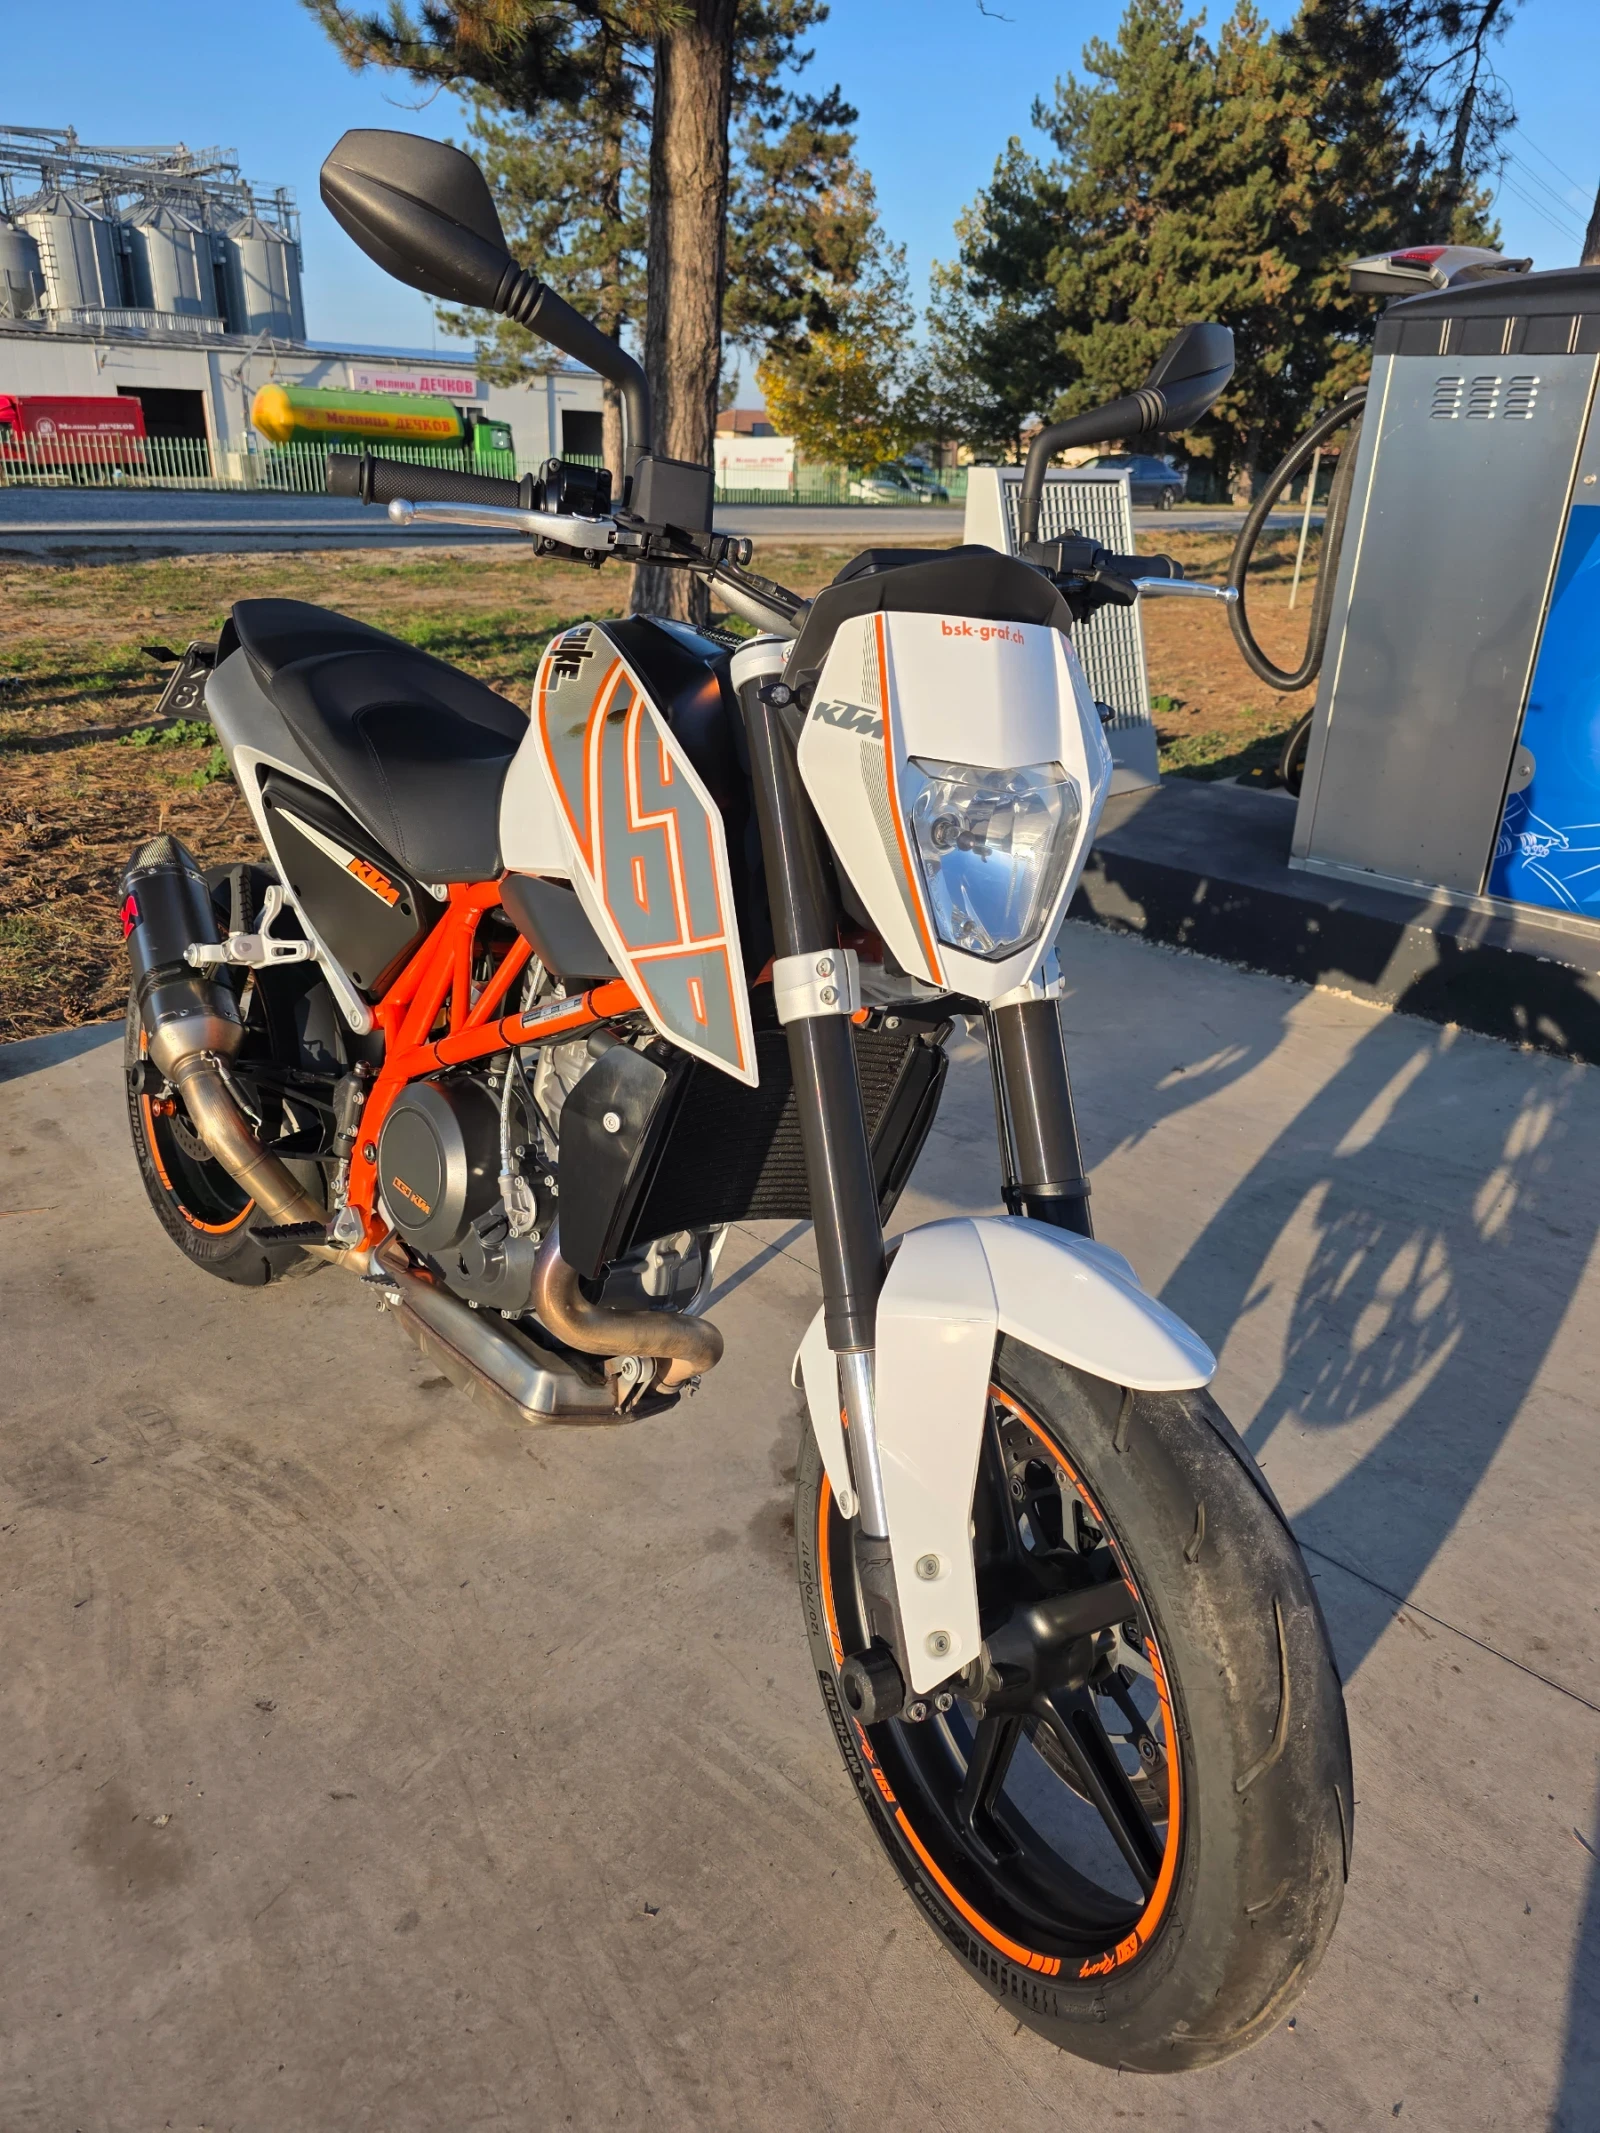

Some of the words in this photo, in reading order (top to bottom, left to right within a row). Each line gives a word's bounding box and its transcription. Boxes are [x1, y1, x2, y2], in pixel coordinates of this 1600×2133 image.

[420, 377, 473, 394] ДЕЧКОВ
[395, 418, 450, 432] ДЕЧКОВ
[942, 621, 1024, 645] bsk-graf.ch
[812, 699, 883, 739] KTM
[348, 858, 400, 906] KTM
[128, 1080, 146, 1157] MICHELI
[410, 1194, 431, 1215] KTM
[801, 1544, 811, 1556] 17
[802, 1560, 816, 1581] ZR
[805, 1583, 820, 1637] 120/70
[823, 1679, 861, 1774] MICHELIN
[871, 1768, 897, 1803] 690
[921, 1892, 949, 1927] FRONT
[1115, 1932, 1138, 1966] 690
